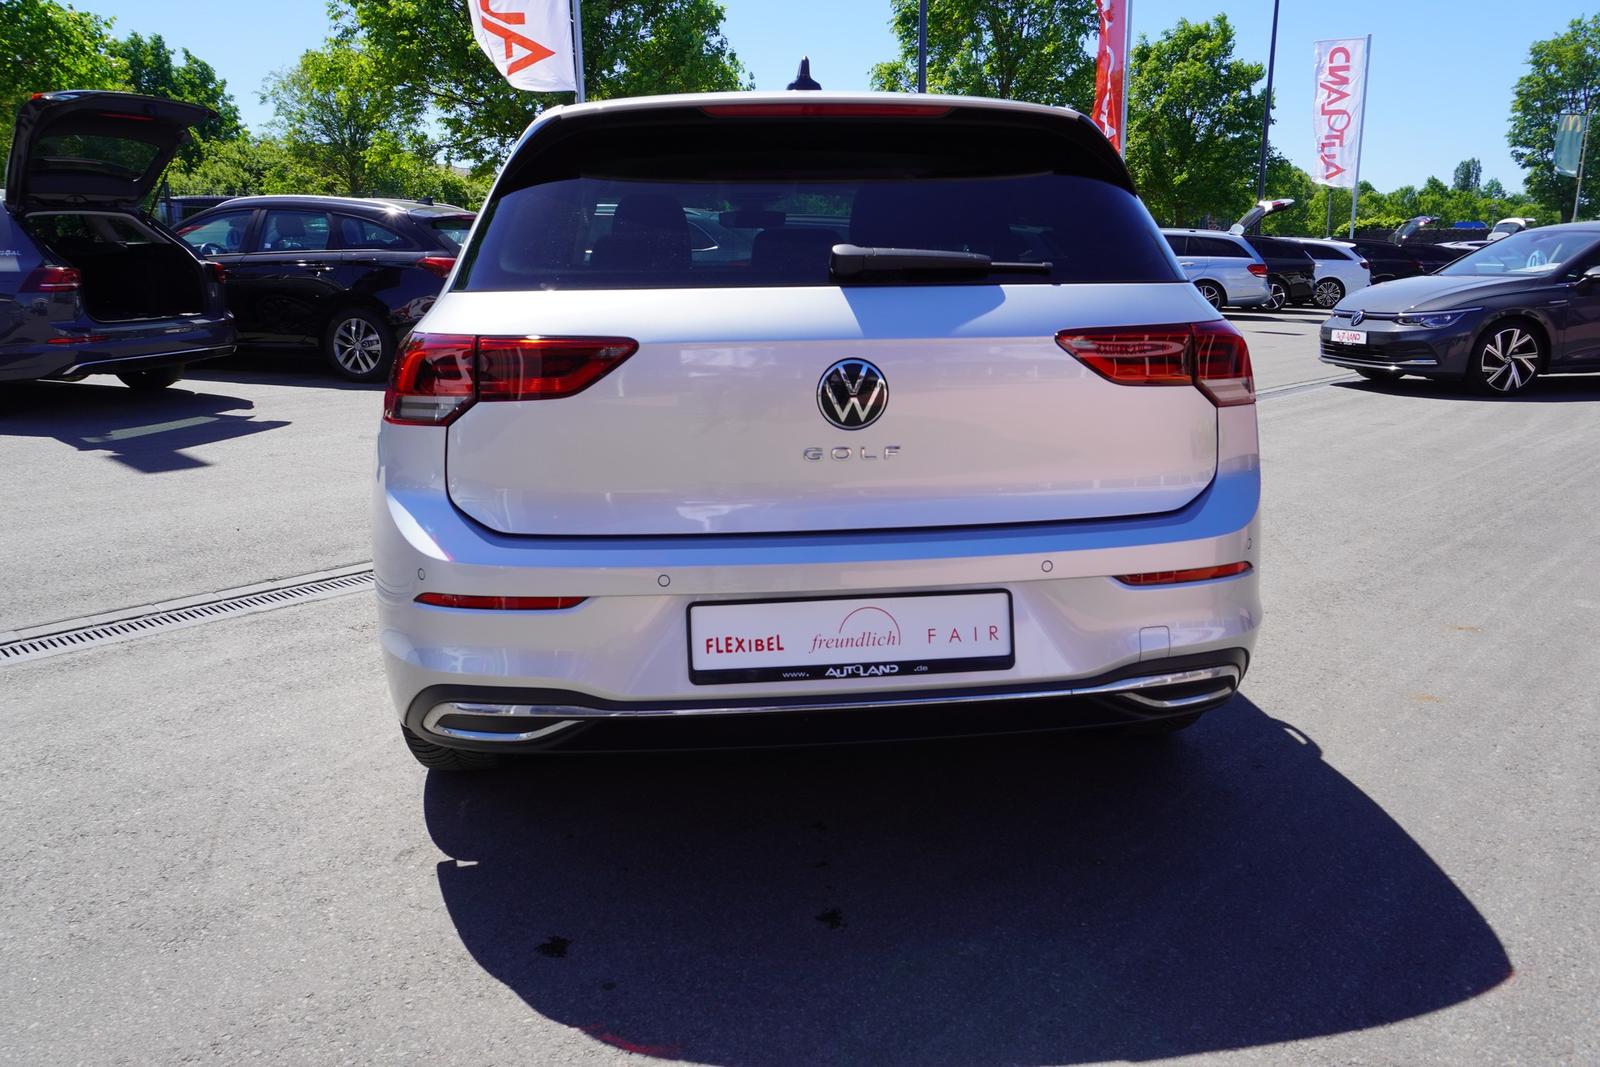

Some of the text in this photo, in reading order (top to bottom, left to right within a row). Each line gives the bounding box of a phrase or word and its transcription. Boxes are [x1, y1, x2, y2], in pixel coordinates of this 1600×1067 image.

[803, 445, 901, 461] GOLF
[705, 625, 1000, 655] FLEXIBEL freundlich FAIR
[824, 664, 900, 678] AUTOLAND
